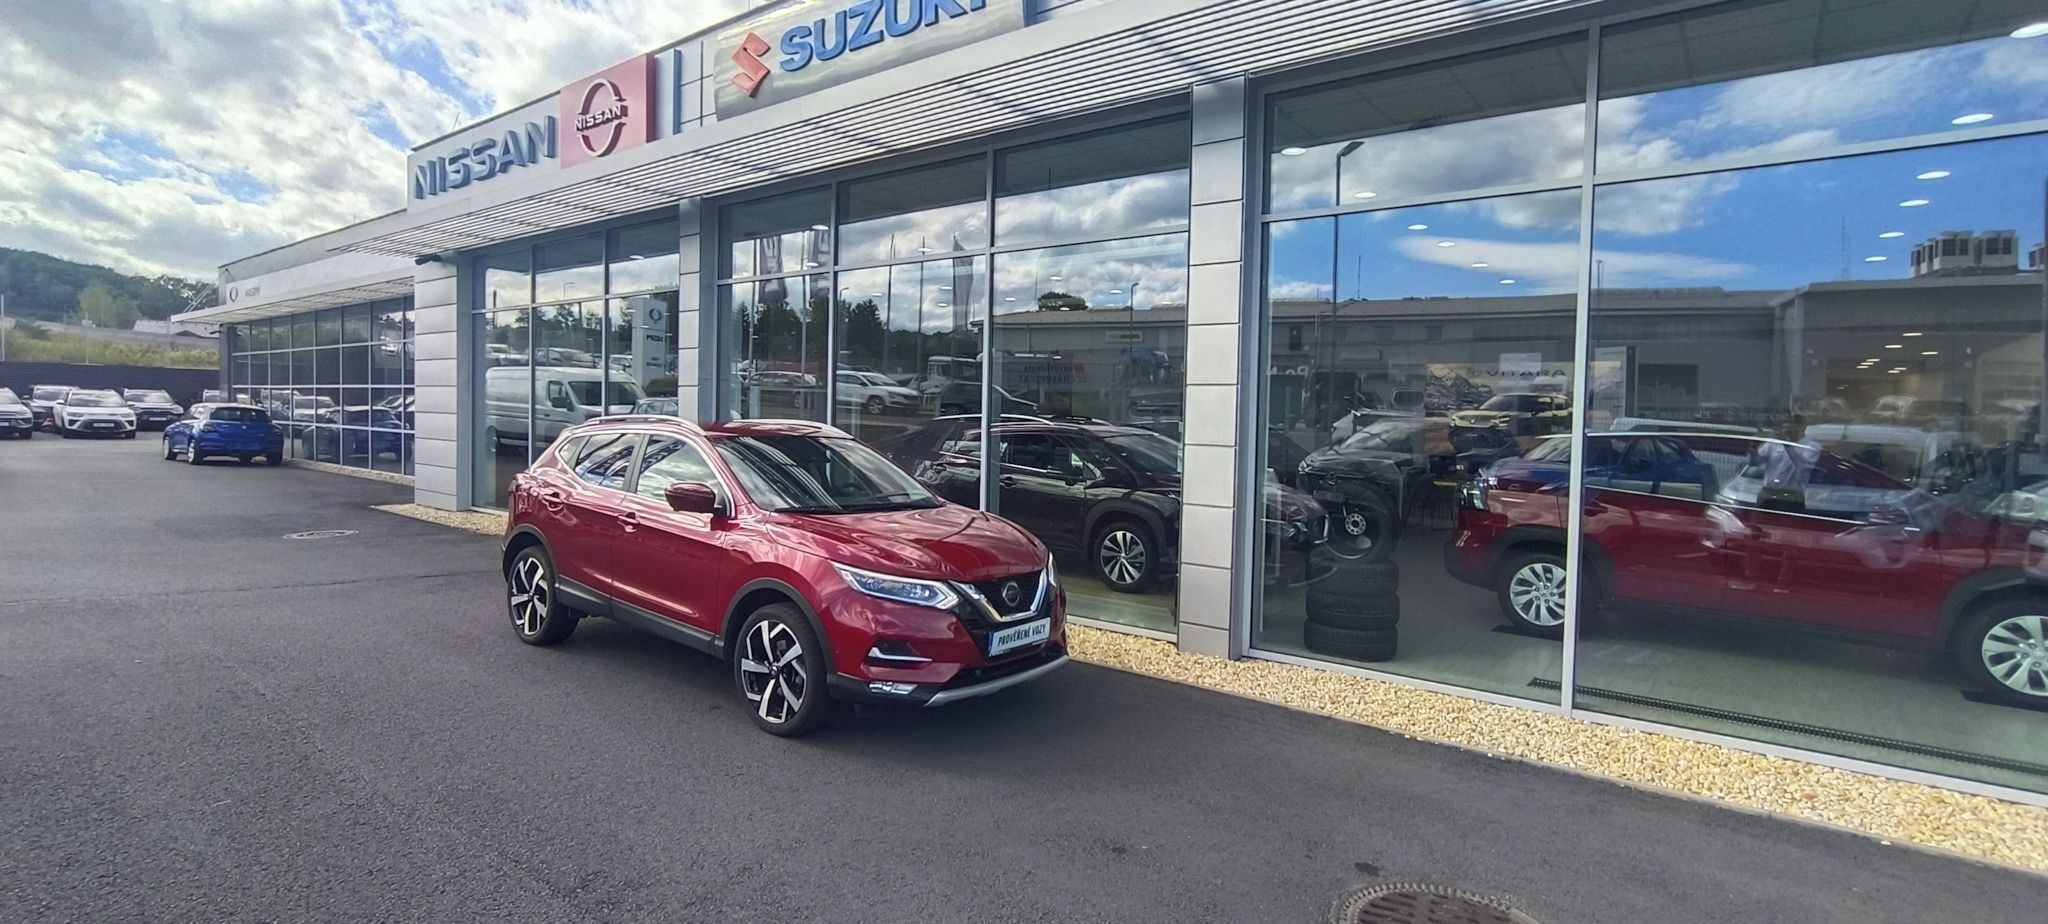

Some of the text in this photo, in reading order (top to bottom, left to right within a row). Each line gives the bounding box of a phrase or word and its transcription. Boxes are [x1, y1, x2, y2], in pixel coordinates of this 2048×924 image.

[575, 104, 624, 131] NISSAN
[413, 115, 556, 200] NISSAN
[997, 624, 1046, 646] PROVĚŘENÉ VOZY
